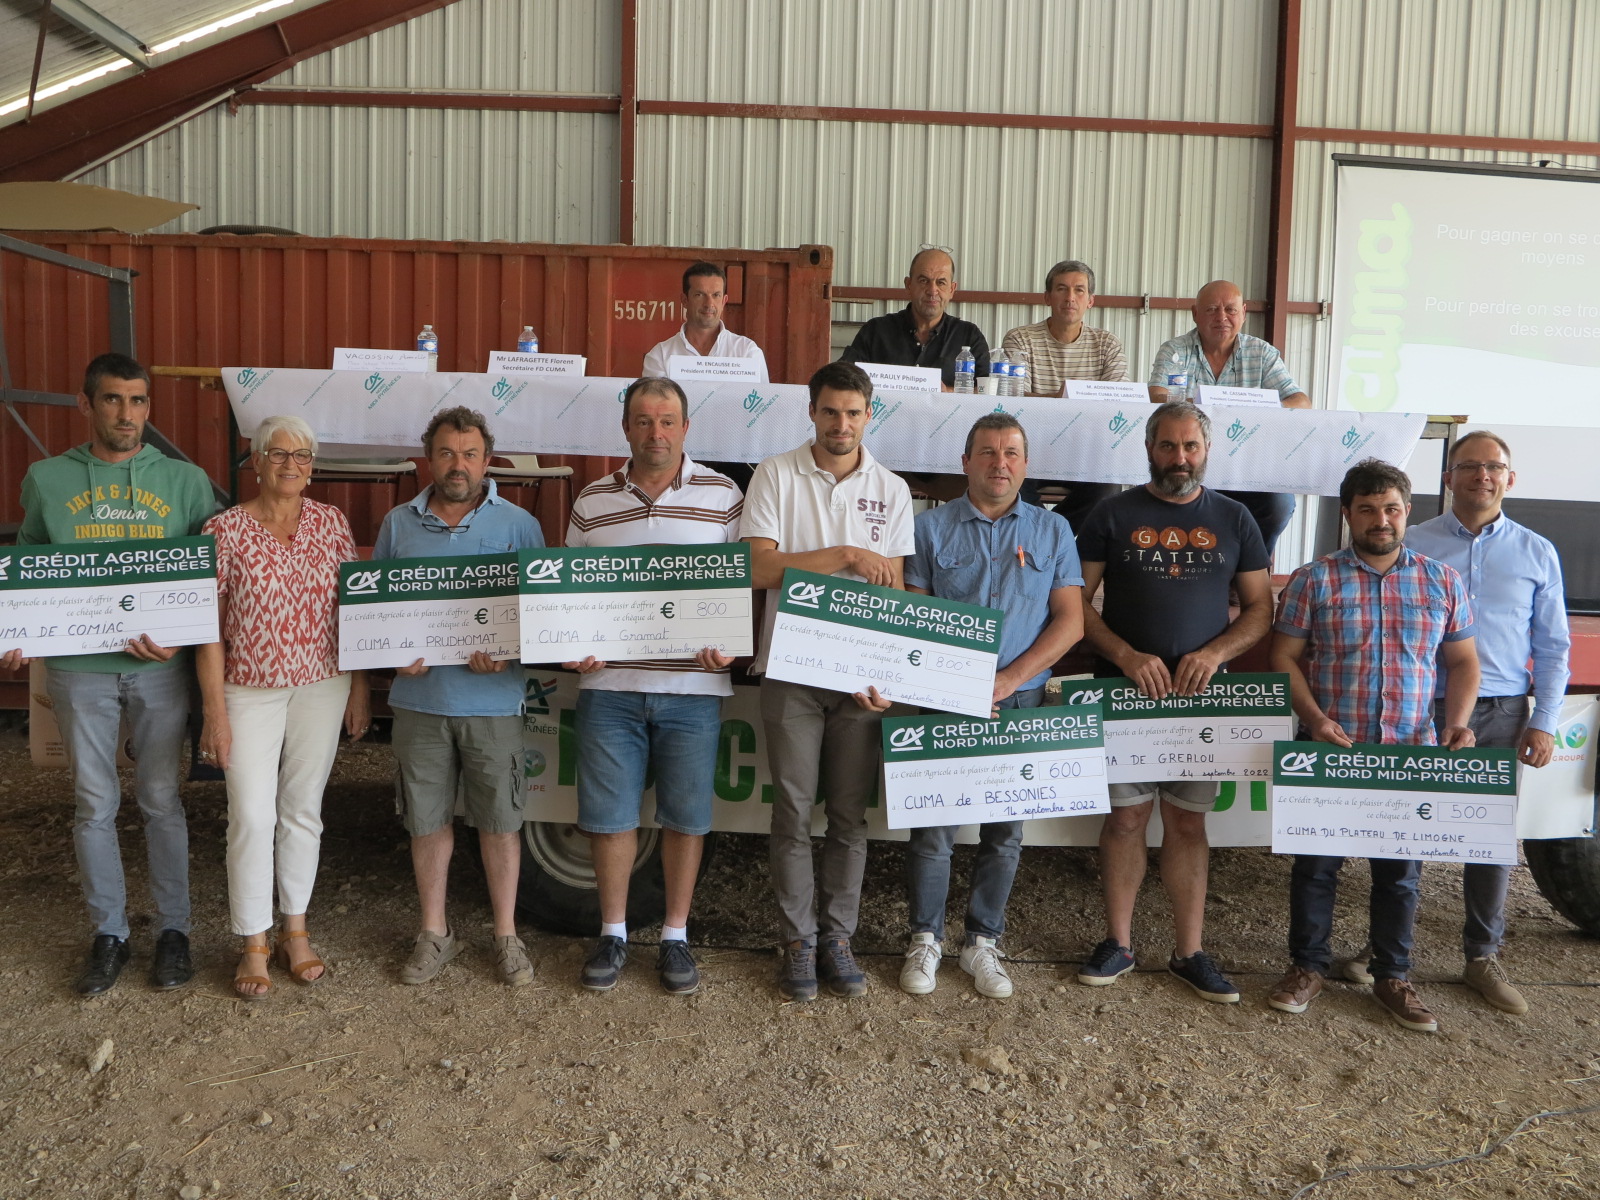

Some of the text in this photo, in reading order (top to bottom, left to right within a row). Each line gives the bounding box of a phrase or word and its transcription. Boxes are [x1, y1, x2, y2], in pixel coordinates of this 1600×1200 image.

[1436, 224, 1476, 240] Pour
[1480, 229, 1538, 245] gagner
[1543, 232, 1562, 244] on
[1568, 233, 1587, 245] se
[1521, 252, 1585, 267] moyens
[614, 300, 675, 321] 556711
[1344, 202, 1413, 412] cuma
[1425, 296, 1600, 318] Pour perdre on se tro
[1510, 321, 1538, 336] des
[508, 356, 548, 364] LAFRAGETTE
[880, 373, 901, 381] RAULY
[901, 375, 927, 383] Philippe
[65, 486, 106, 515] JACK
[109, 484, 120, 499] &
[90, 503, 149, 520] Denim
[75, 524, 165, 539] INDIGO BLUE
[871, 525, 880, 542] 6
[1138, 530, 1210, 546] GAS
[19, 546, 210, 569] CRÉDIT AGRICOLE
[571, 553, 745, 572] CRÉDIT AGRICOLE
[1123, 549, 1226, 564] STATION
[20, 559, 211, 580] NORD MIDI-PYRÉNÉES
[388, 563, 519, 581] CRÉDIT AGRIC
[571, 566, 746, 583] NORD MIDI-PYRÉNÉES
[388, 575, 519, 593] NORD MIDI-PYRÉ
[536, 601, 558, 612] Crédit
[561, 602, 589, 614] Agricole
[598, 602, 604, 610] le
[605, 601, 629, 613] plaisir
[630, 600, 655, 613] d'offrir
[660, 602, 727, 619] € 800
[831, 589, 997, 633] CRÉDIT AGRICOLE
[622, 613, 645, 624] chèque
[647, 613, 656, 621] de
[829, 602, 995, 644] NORD MIDI-PYRÉNÉES
[40, 626, 58, 638] DE
[68, 621, 124, 636] COMIAC
[538, 627, 670, 644] CUMA de Gramat
[357, 633, 498, 651] CUMA de PRUDHOMAT
[784, 653, 905, 684] CUMA DU BOURG
[1195, 684, 1285, 698] GRICOLE
[1112, 696, 1286, 711] NORD MIDI-PYRÉNÉES
[932, 714, 1098, 738] CRÉDIT AGRICOLE
[1230, 728, 1263, 740] 500
[933, 728, 1099, 750] NORD MIDI-PYRÉNÉES
[1130, 755, 1147, 765] DE
[1158, 753, 1215, 764] GREALOU
[1325, 752, 1510, 774] CRÉDIT AGRICOLE
[1552, 754, 1585, 762] GROUPE
[1049, 761, 1082, 778] 600
[1179, 769, 1193, 777] 14
[1202, 769, 1235, 779] septembre
[1325, 768, 1510, 785] NORD MIDI-PYRÉNÉES
[904, 786, 1057, 810] CUMA de BESSONIES
[1003, 800, 1097, 819] 14 septembre 2022
[1450, 804, 1487, 819] 500
[1286, 827, 1465, 843] CUMA DU PLATEAU DE LIMOGNE
[1395, 847, 1492, 859] 14 septembre 2022
